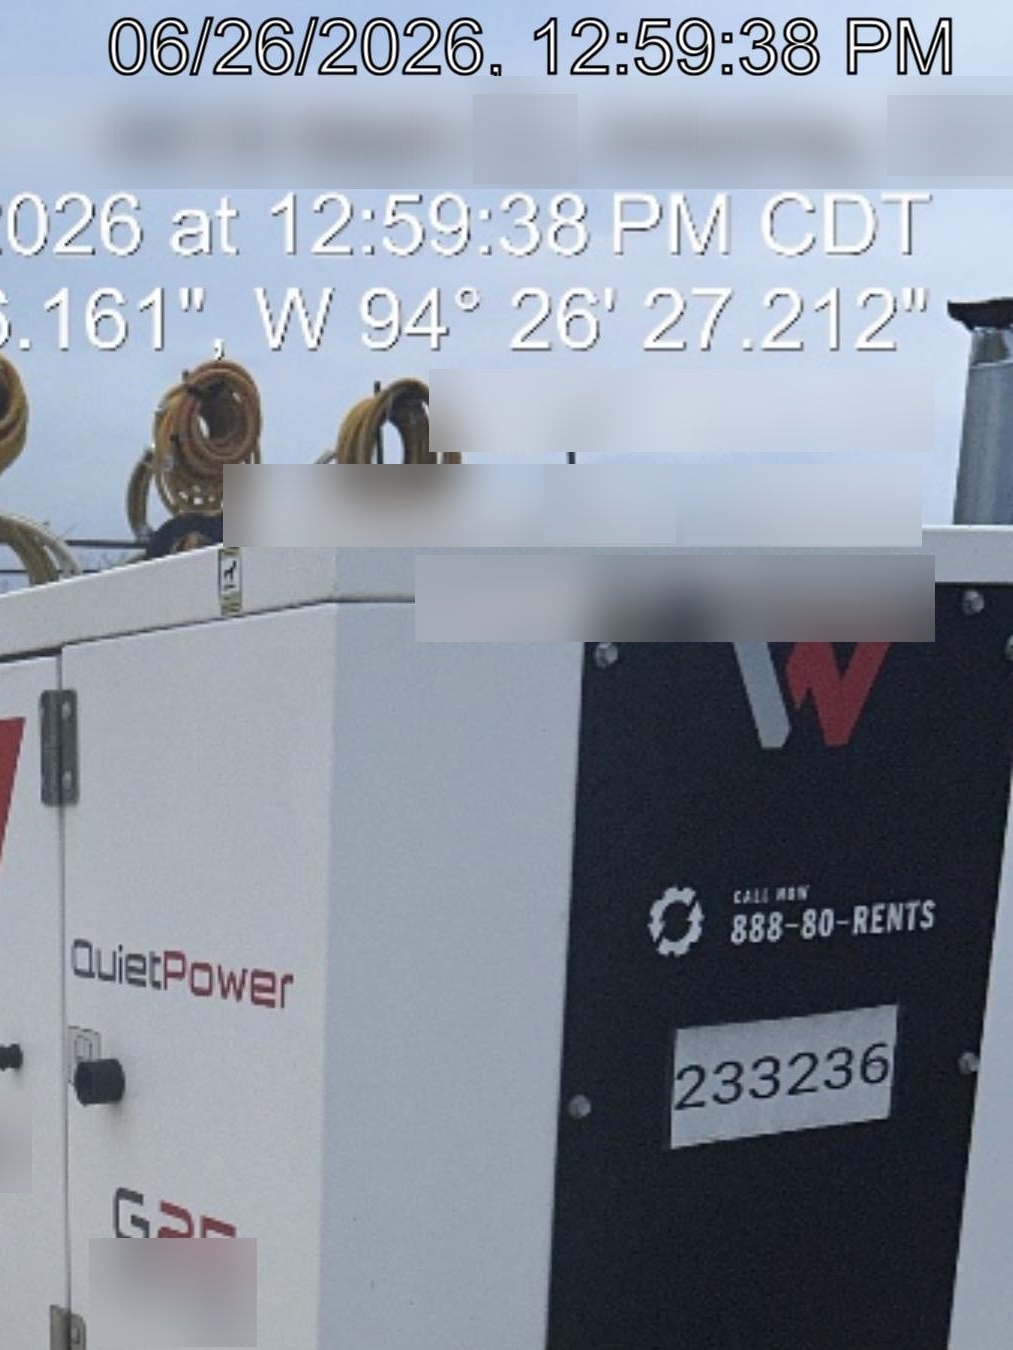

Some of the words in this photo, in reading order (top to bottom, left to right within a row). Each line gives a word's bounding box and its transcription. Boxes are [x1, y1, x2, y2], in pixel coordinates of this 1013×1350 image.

[730, 899, 936, 945] 888-80-RENTS
[733, 888, 769, 905] CALL
[71, 938, 294, 1009] QuietPower
[674, 1042, 890, 1111] 233236
